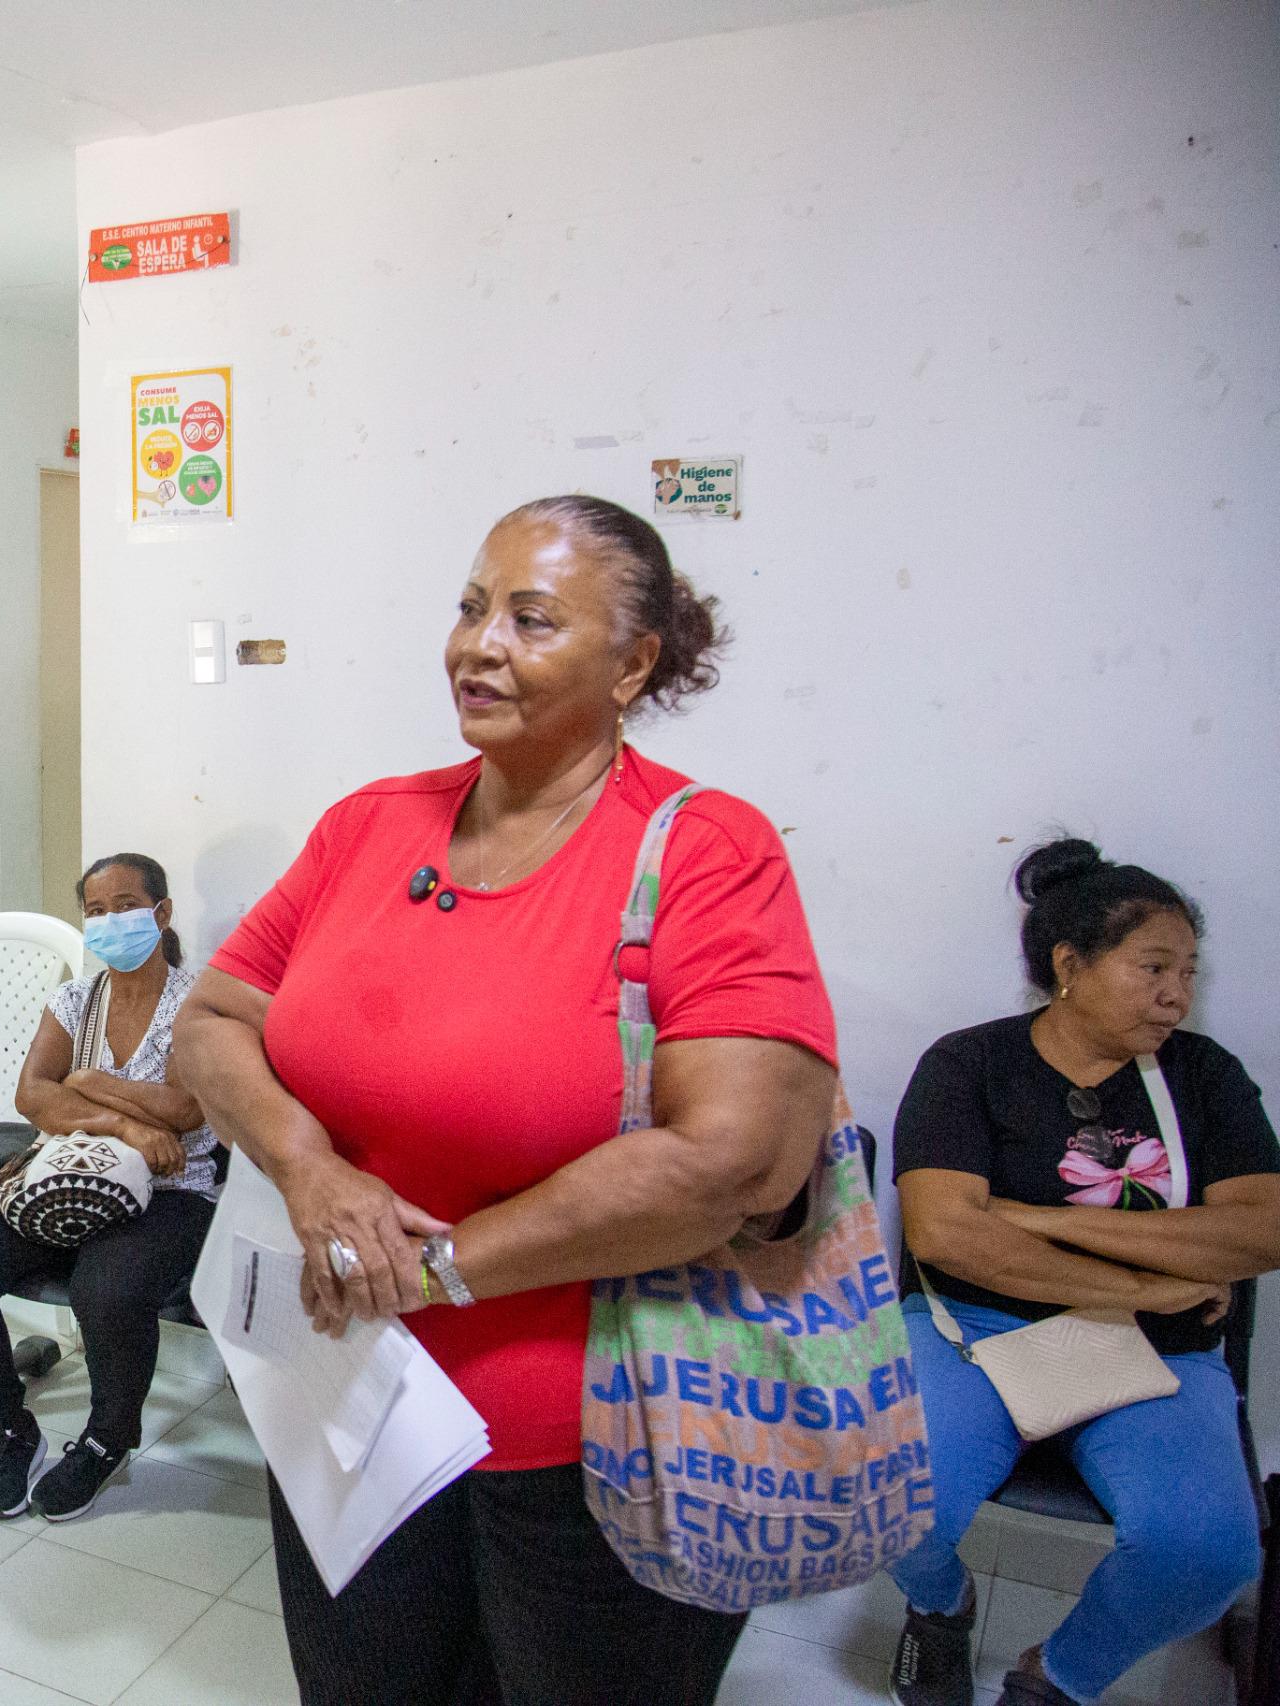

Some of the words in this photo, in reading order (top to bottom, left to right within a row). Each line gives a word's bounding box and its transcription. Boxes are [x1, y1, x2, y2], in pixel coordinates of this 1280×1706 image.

[122, 226, 148, 238] CENTRO
[150, 221, 182, 235] MATERNO
[183, 216, 213, 230] INFANTIL
[137, 238, 168, 257] SALA
[171, 236, 188, 252] DE
[139, 252, 186, 274] ESPERA
[140, 386, 176, 396] CONSUME
[138, 395, 179, 407] MENOS
[138, 405, 180, 426] SAL
[681, 466, 733, 481] Higiene
[698, 481, 716, 492] de
[684, 493, 732, 503] manos
